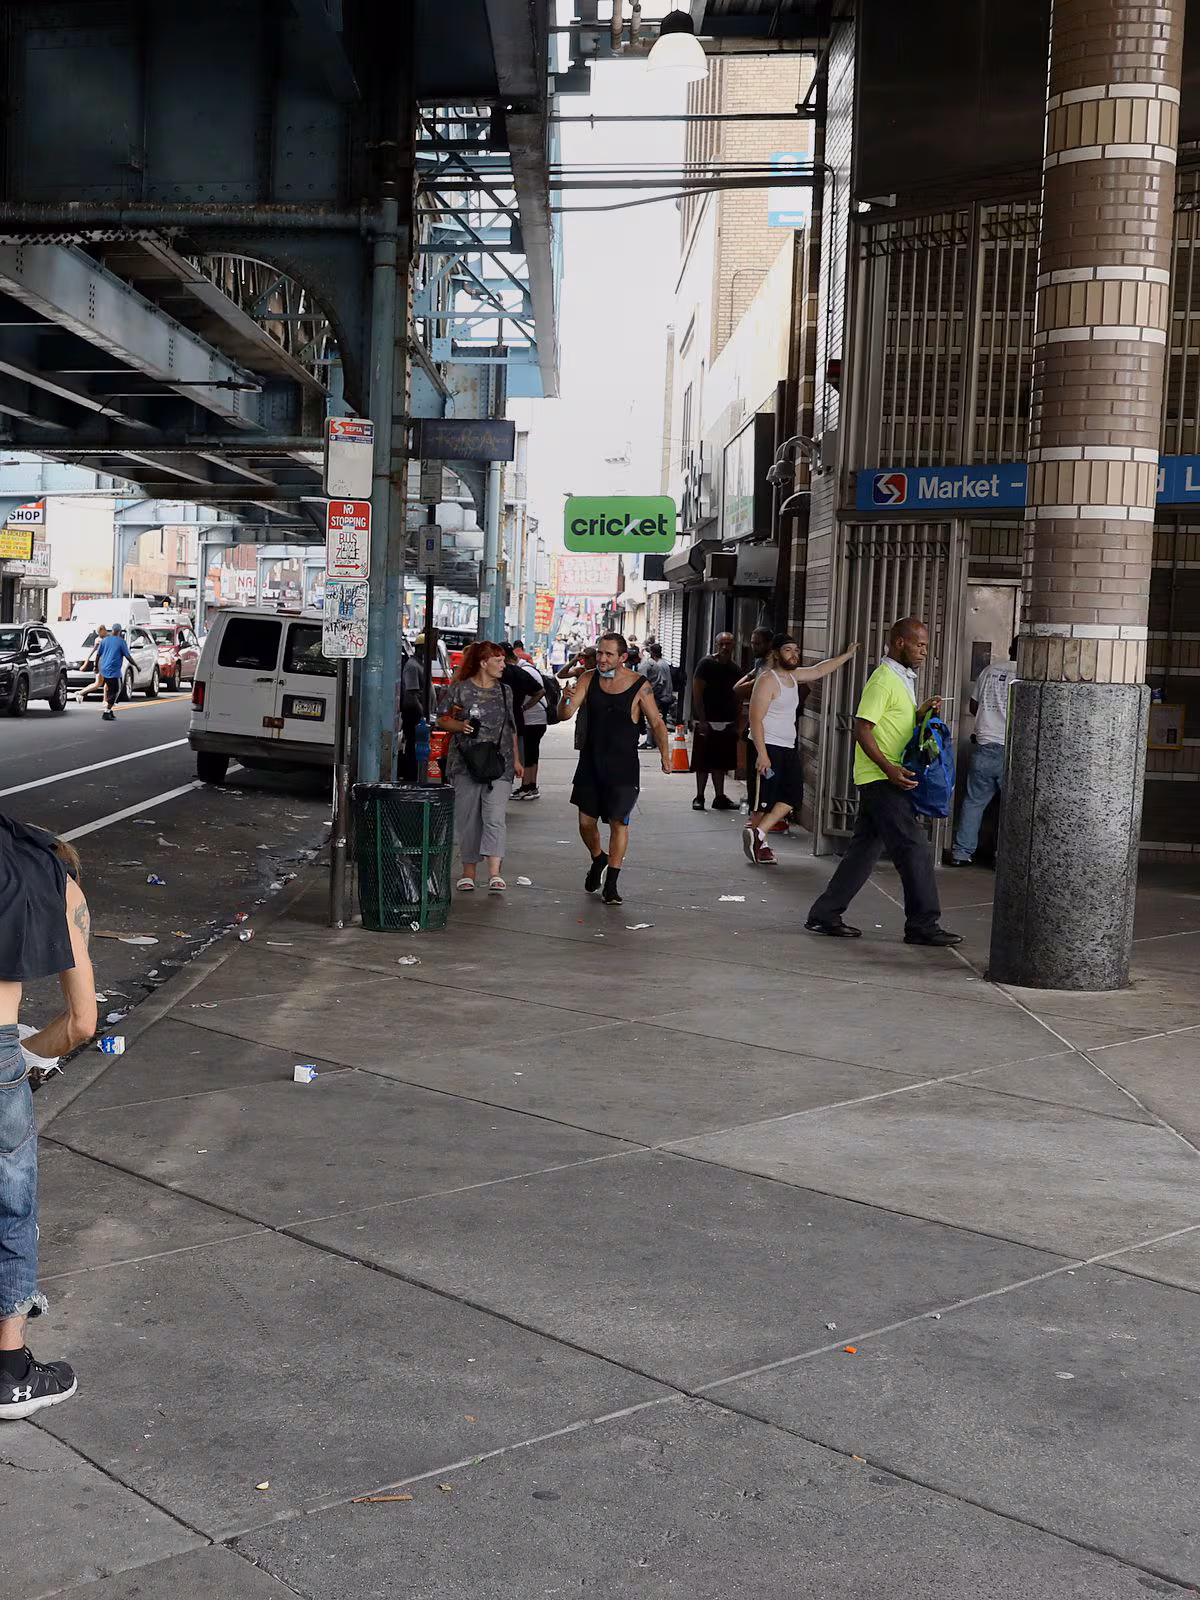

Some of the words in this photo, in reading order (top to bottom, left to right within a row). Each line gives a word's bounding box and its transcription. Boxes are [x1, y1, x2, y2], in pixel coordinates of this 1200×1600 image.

[917, 474, 1000, 500] Market
[9, 510, 40, 521] SHOP
[330, 516, 367, 528] STOPPING
[571, 513, 668, 536] cricket
[339, 532, 357, 544] BUS
[336, 547, 360, 560] ZE
